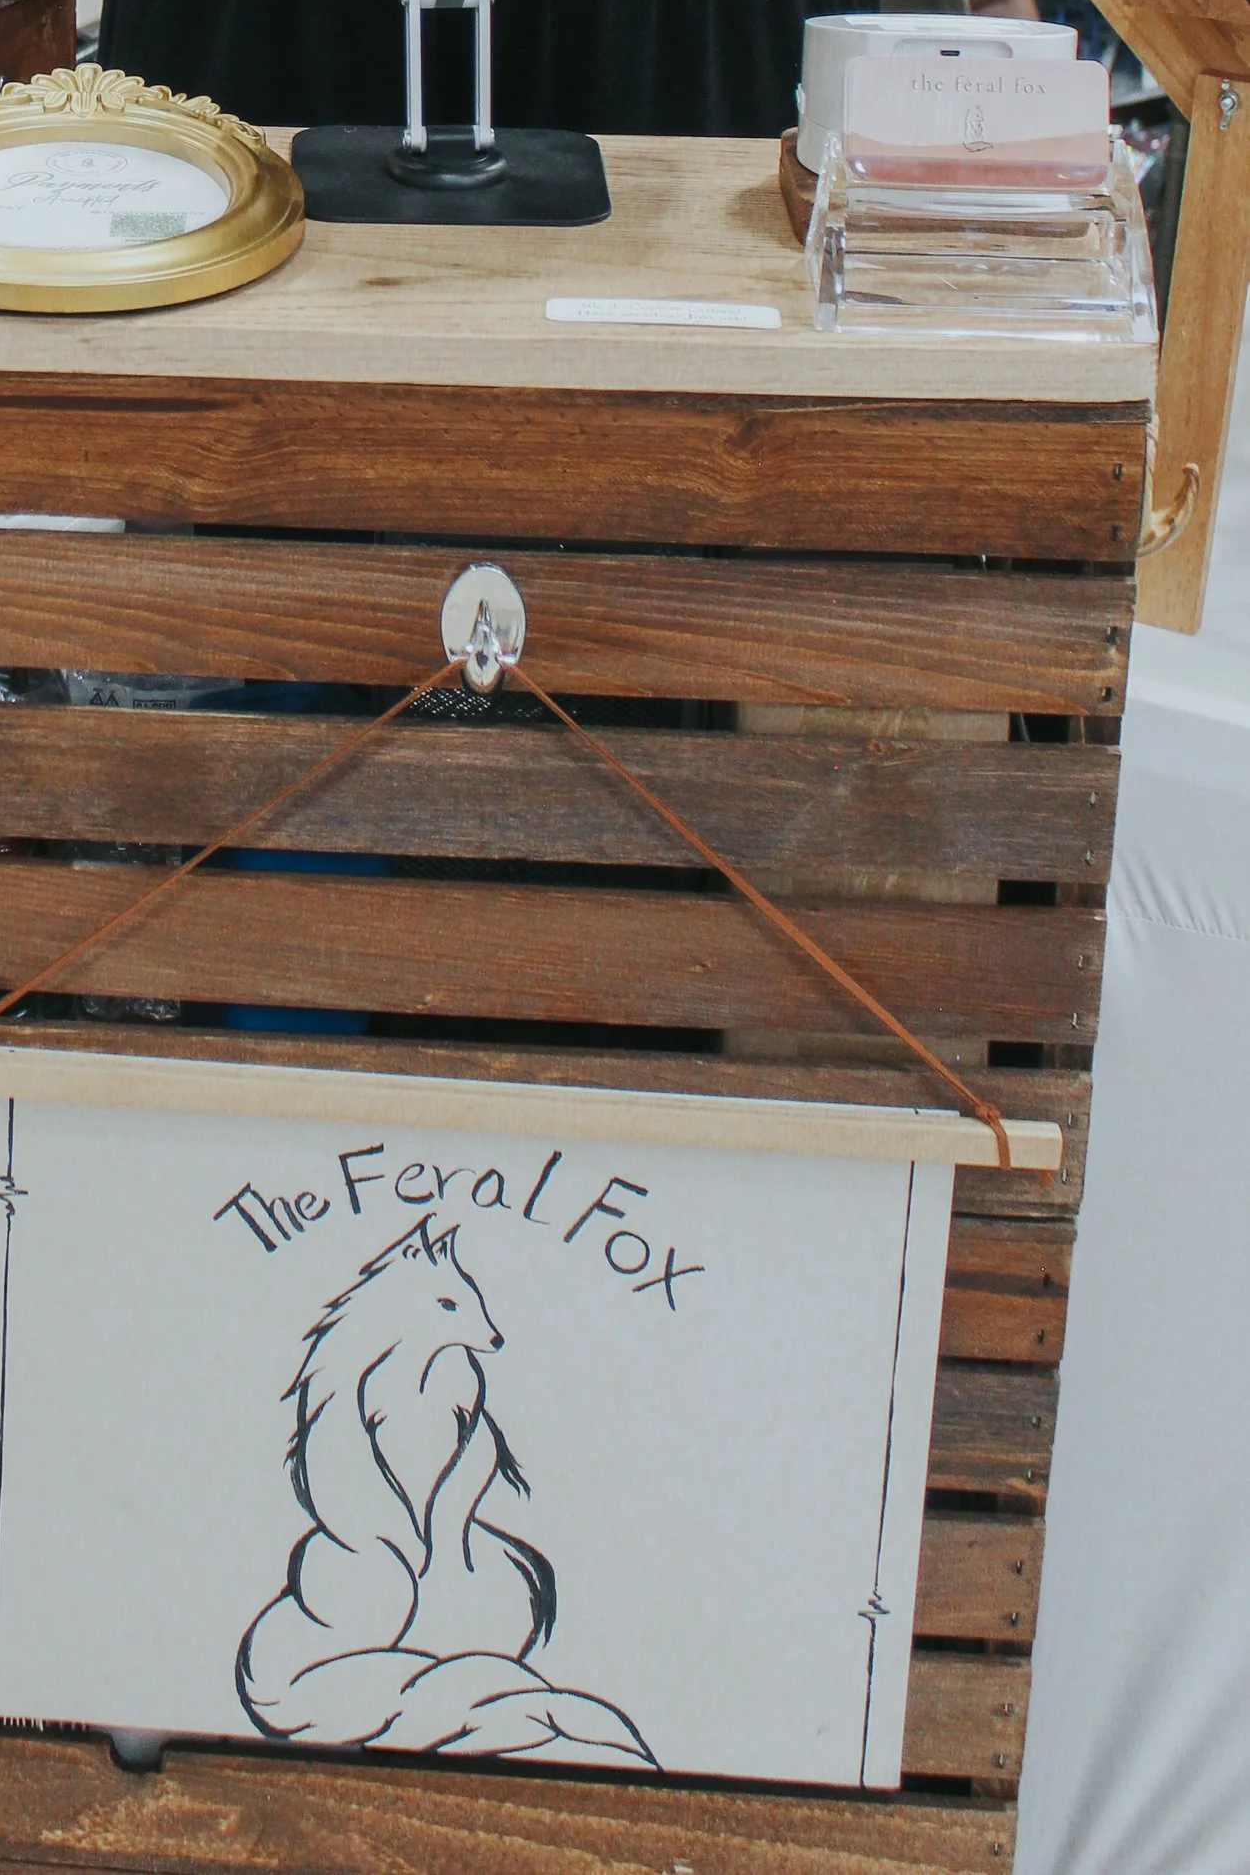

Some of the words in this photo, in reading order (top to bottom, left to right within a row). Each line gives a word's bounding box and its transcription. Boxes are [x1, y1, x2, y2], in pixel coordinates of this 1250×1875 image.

[912, 74, 944, 91] the
[955, 74, 1003, 93] feral
[1014, 76, 1046, 94] fox
[33, 191, 120, 208] Accepted
[630, 304, 679, 312] Custom
[213, 1182, 331, 1252] The
[338, 1142, 563, 1226] Feral
[563, 1176, 706, 1311] Fox
